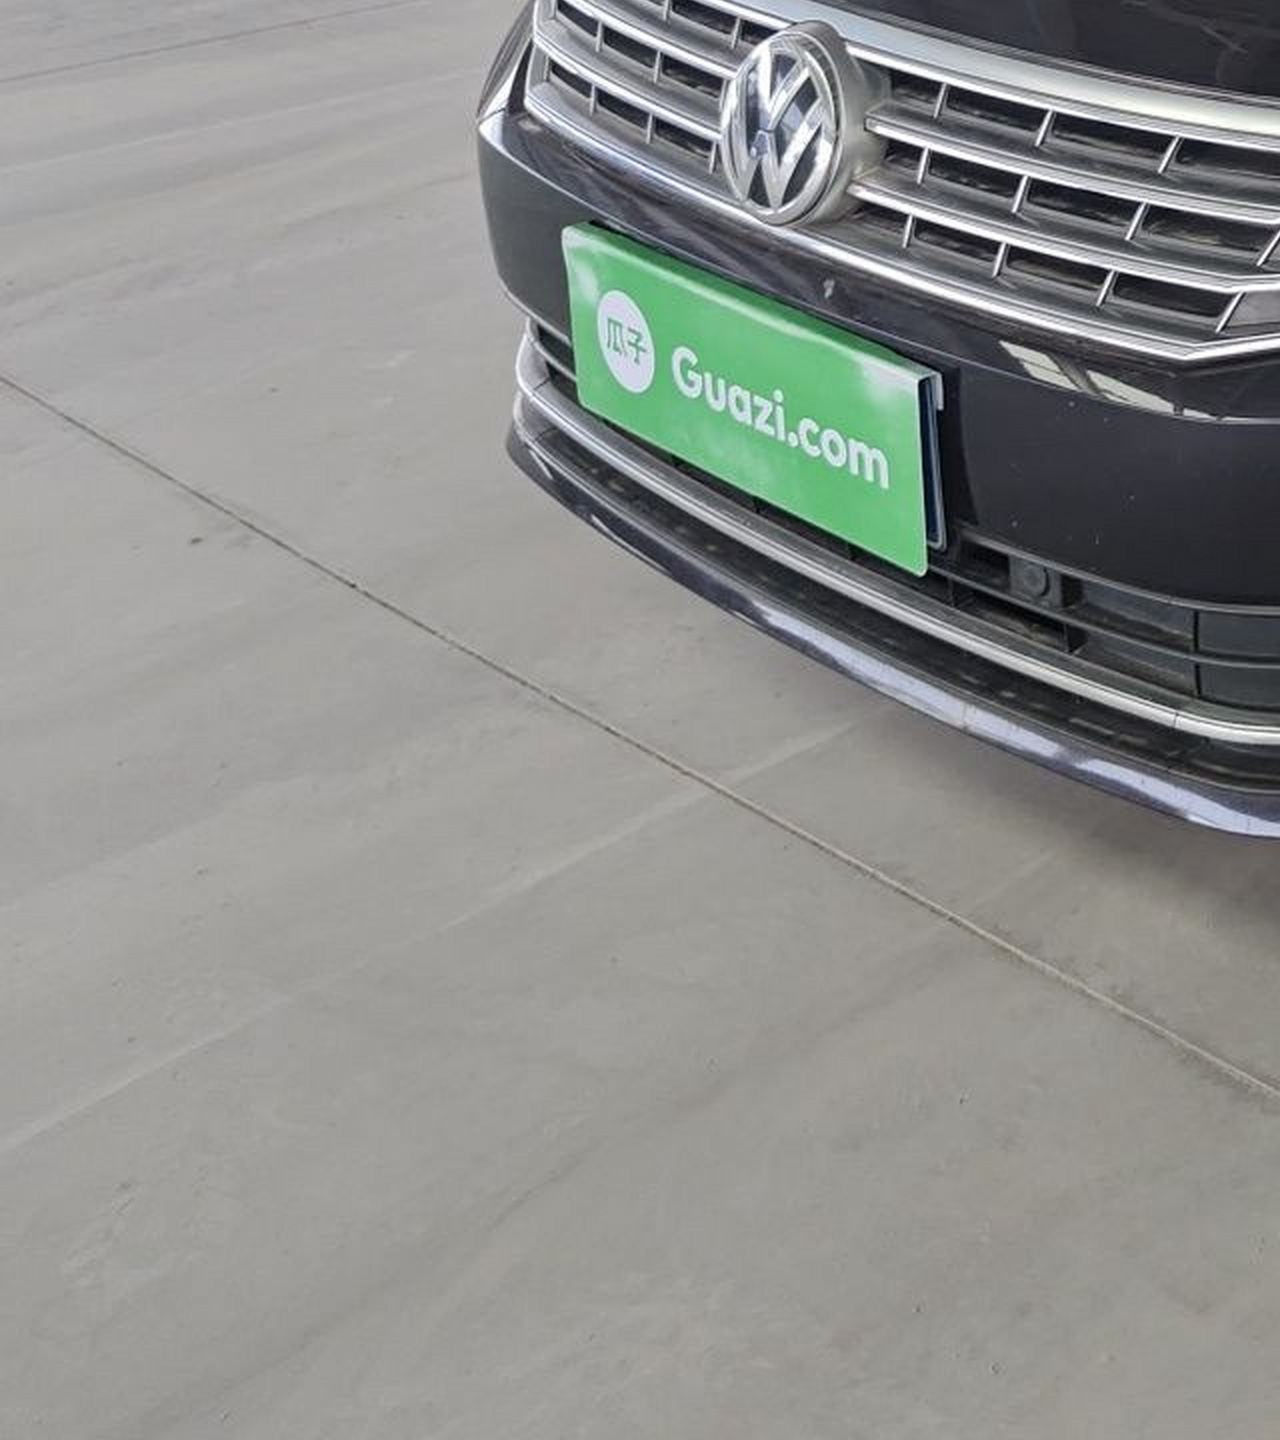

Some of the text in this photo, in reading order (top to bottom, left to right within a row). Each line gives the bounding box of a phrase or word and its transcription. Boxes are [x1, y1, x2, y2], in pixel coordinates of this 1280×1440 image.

[729, 35, 836, 219] VW
[606, 317, 648, 365] 瓜子
[671, 346, 890, 490] Guazi.com
